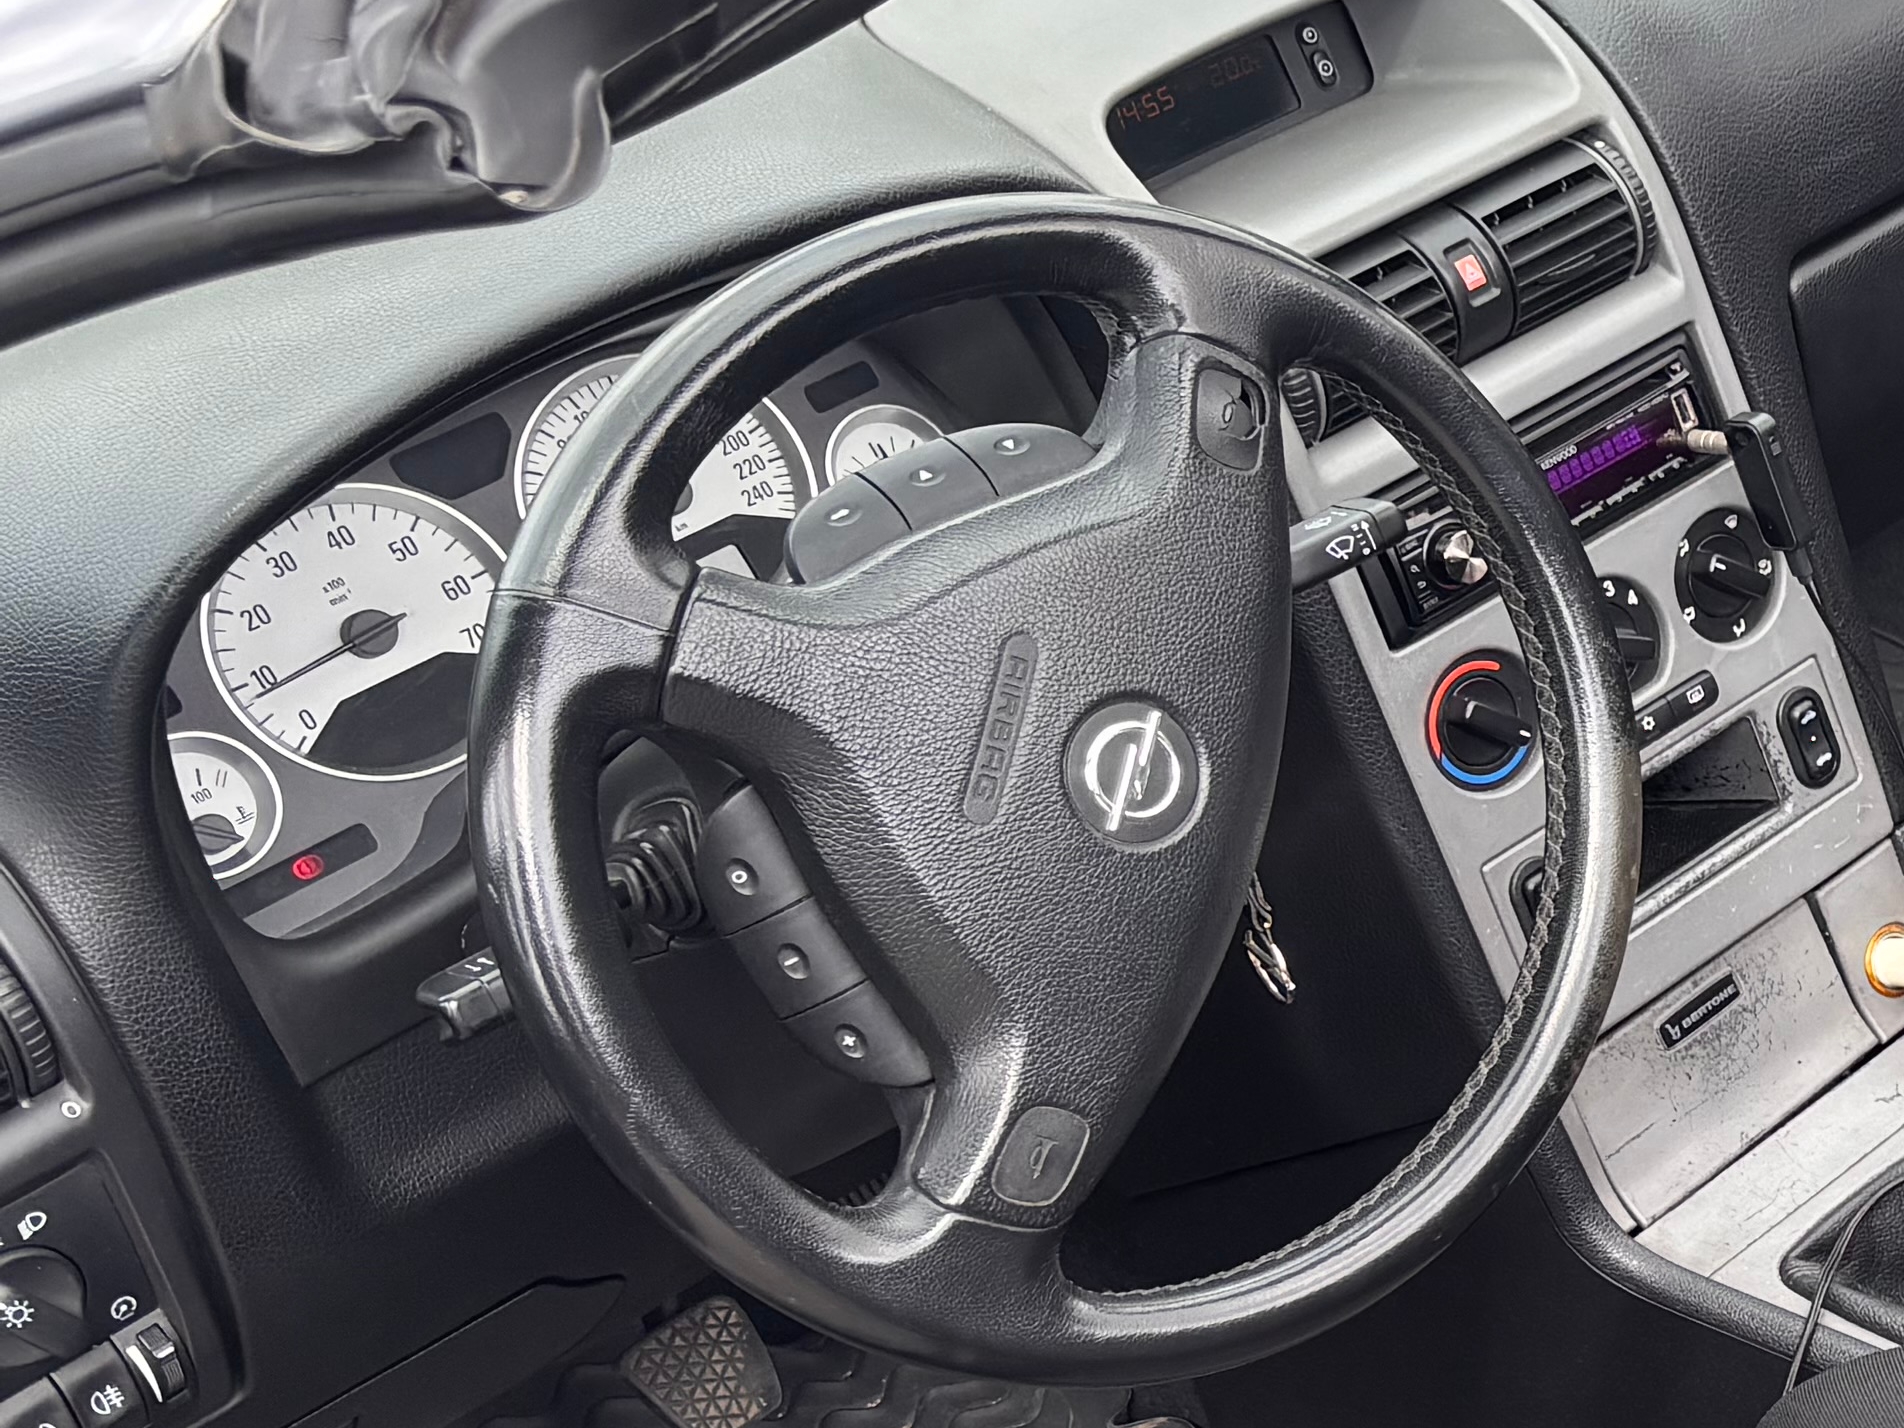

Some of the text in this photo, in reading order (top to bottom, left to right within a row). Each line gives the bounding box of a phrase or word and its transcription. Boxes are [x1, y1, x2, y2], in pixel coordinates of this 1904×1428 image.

[719, 429, 750, 458] 200
[1540, 444, 1578, 471] KENWOOD
[733, 453, 767, 481] 220
[740, 480, 775, 508] 240
[326, 524, 357, 551] 40
[387, 534, 420, 563] 50
[265, 549, 299, 579] 30
[440, 574, 473, 602] 60
[1602, 580, 1616, 598] 3
[1627, 589, 1639, 606] 4
[239, 603, 273, 633] 20
[458, 623, 486, 649] 70
[249, 664, 279, 690] 10
[297, 708, 318, 730] 0
[972, 655, 1030, 802] AIRBAG
[190, 787, 213, 805] 100
[1681, 983, 1738, 1029] BERTONE
